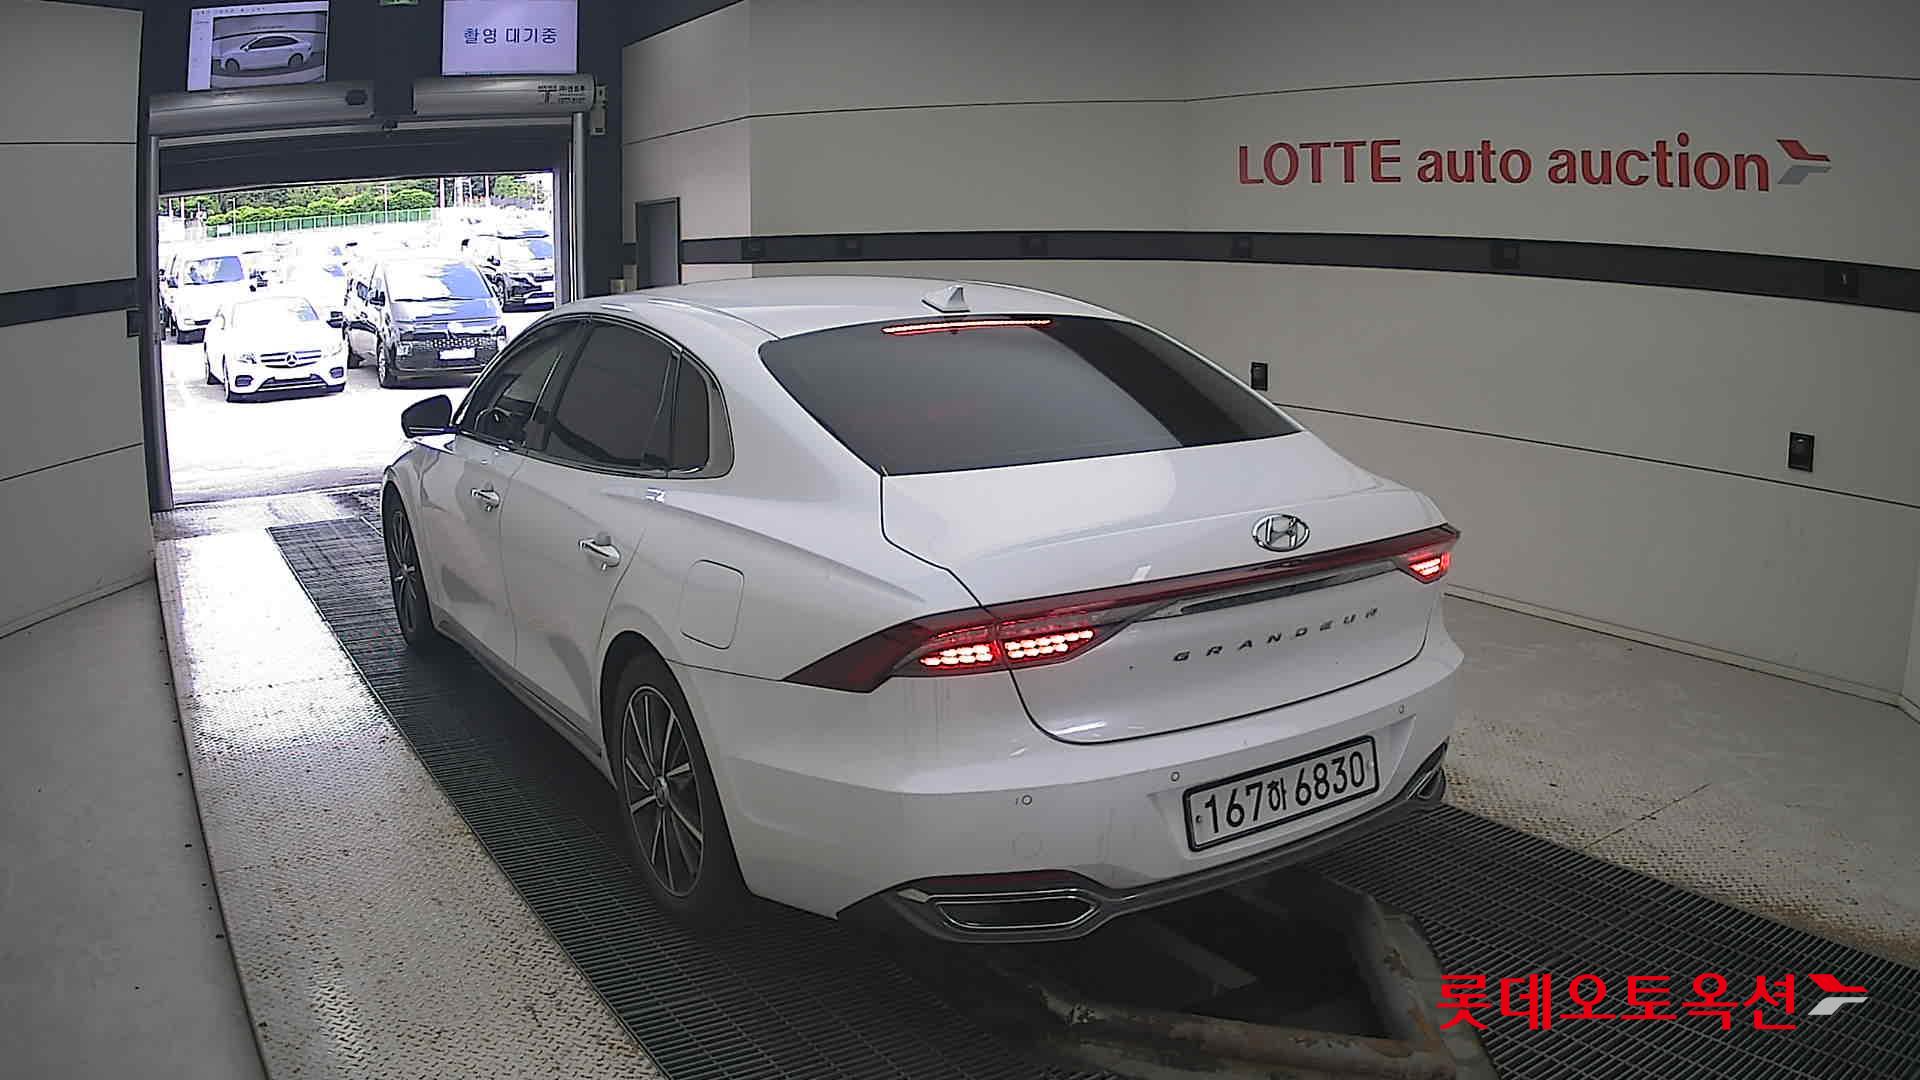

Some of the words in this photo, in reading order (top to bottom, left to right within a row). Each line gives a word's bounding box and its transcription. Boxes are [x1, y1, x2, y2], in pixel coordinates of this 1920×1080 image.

[463, 27, 497, 45] 촬영
[505, 27, 558, 45] 대기중
[1239, 139, 1402, 186] LOTTE
[1416, 141, 1533, 185] auto
[1548, 132, 1771, 193] auction
[1171, 606, 1380, 663] GRANDEUR
[1204, 779, 1288, 834] 167하
[1294, 750, 1366, 808] 6830
